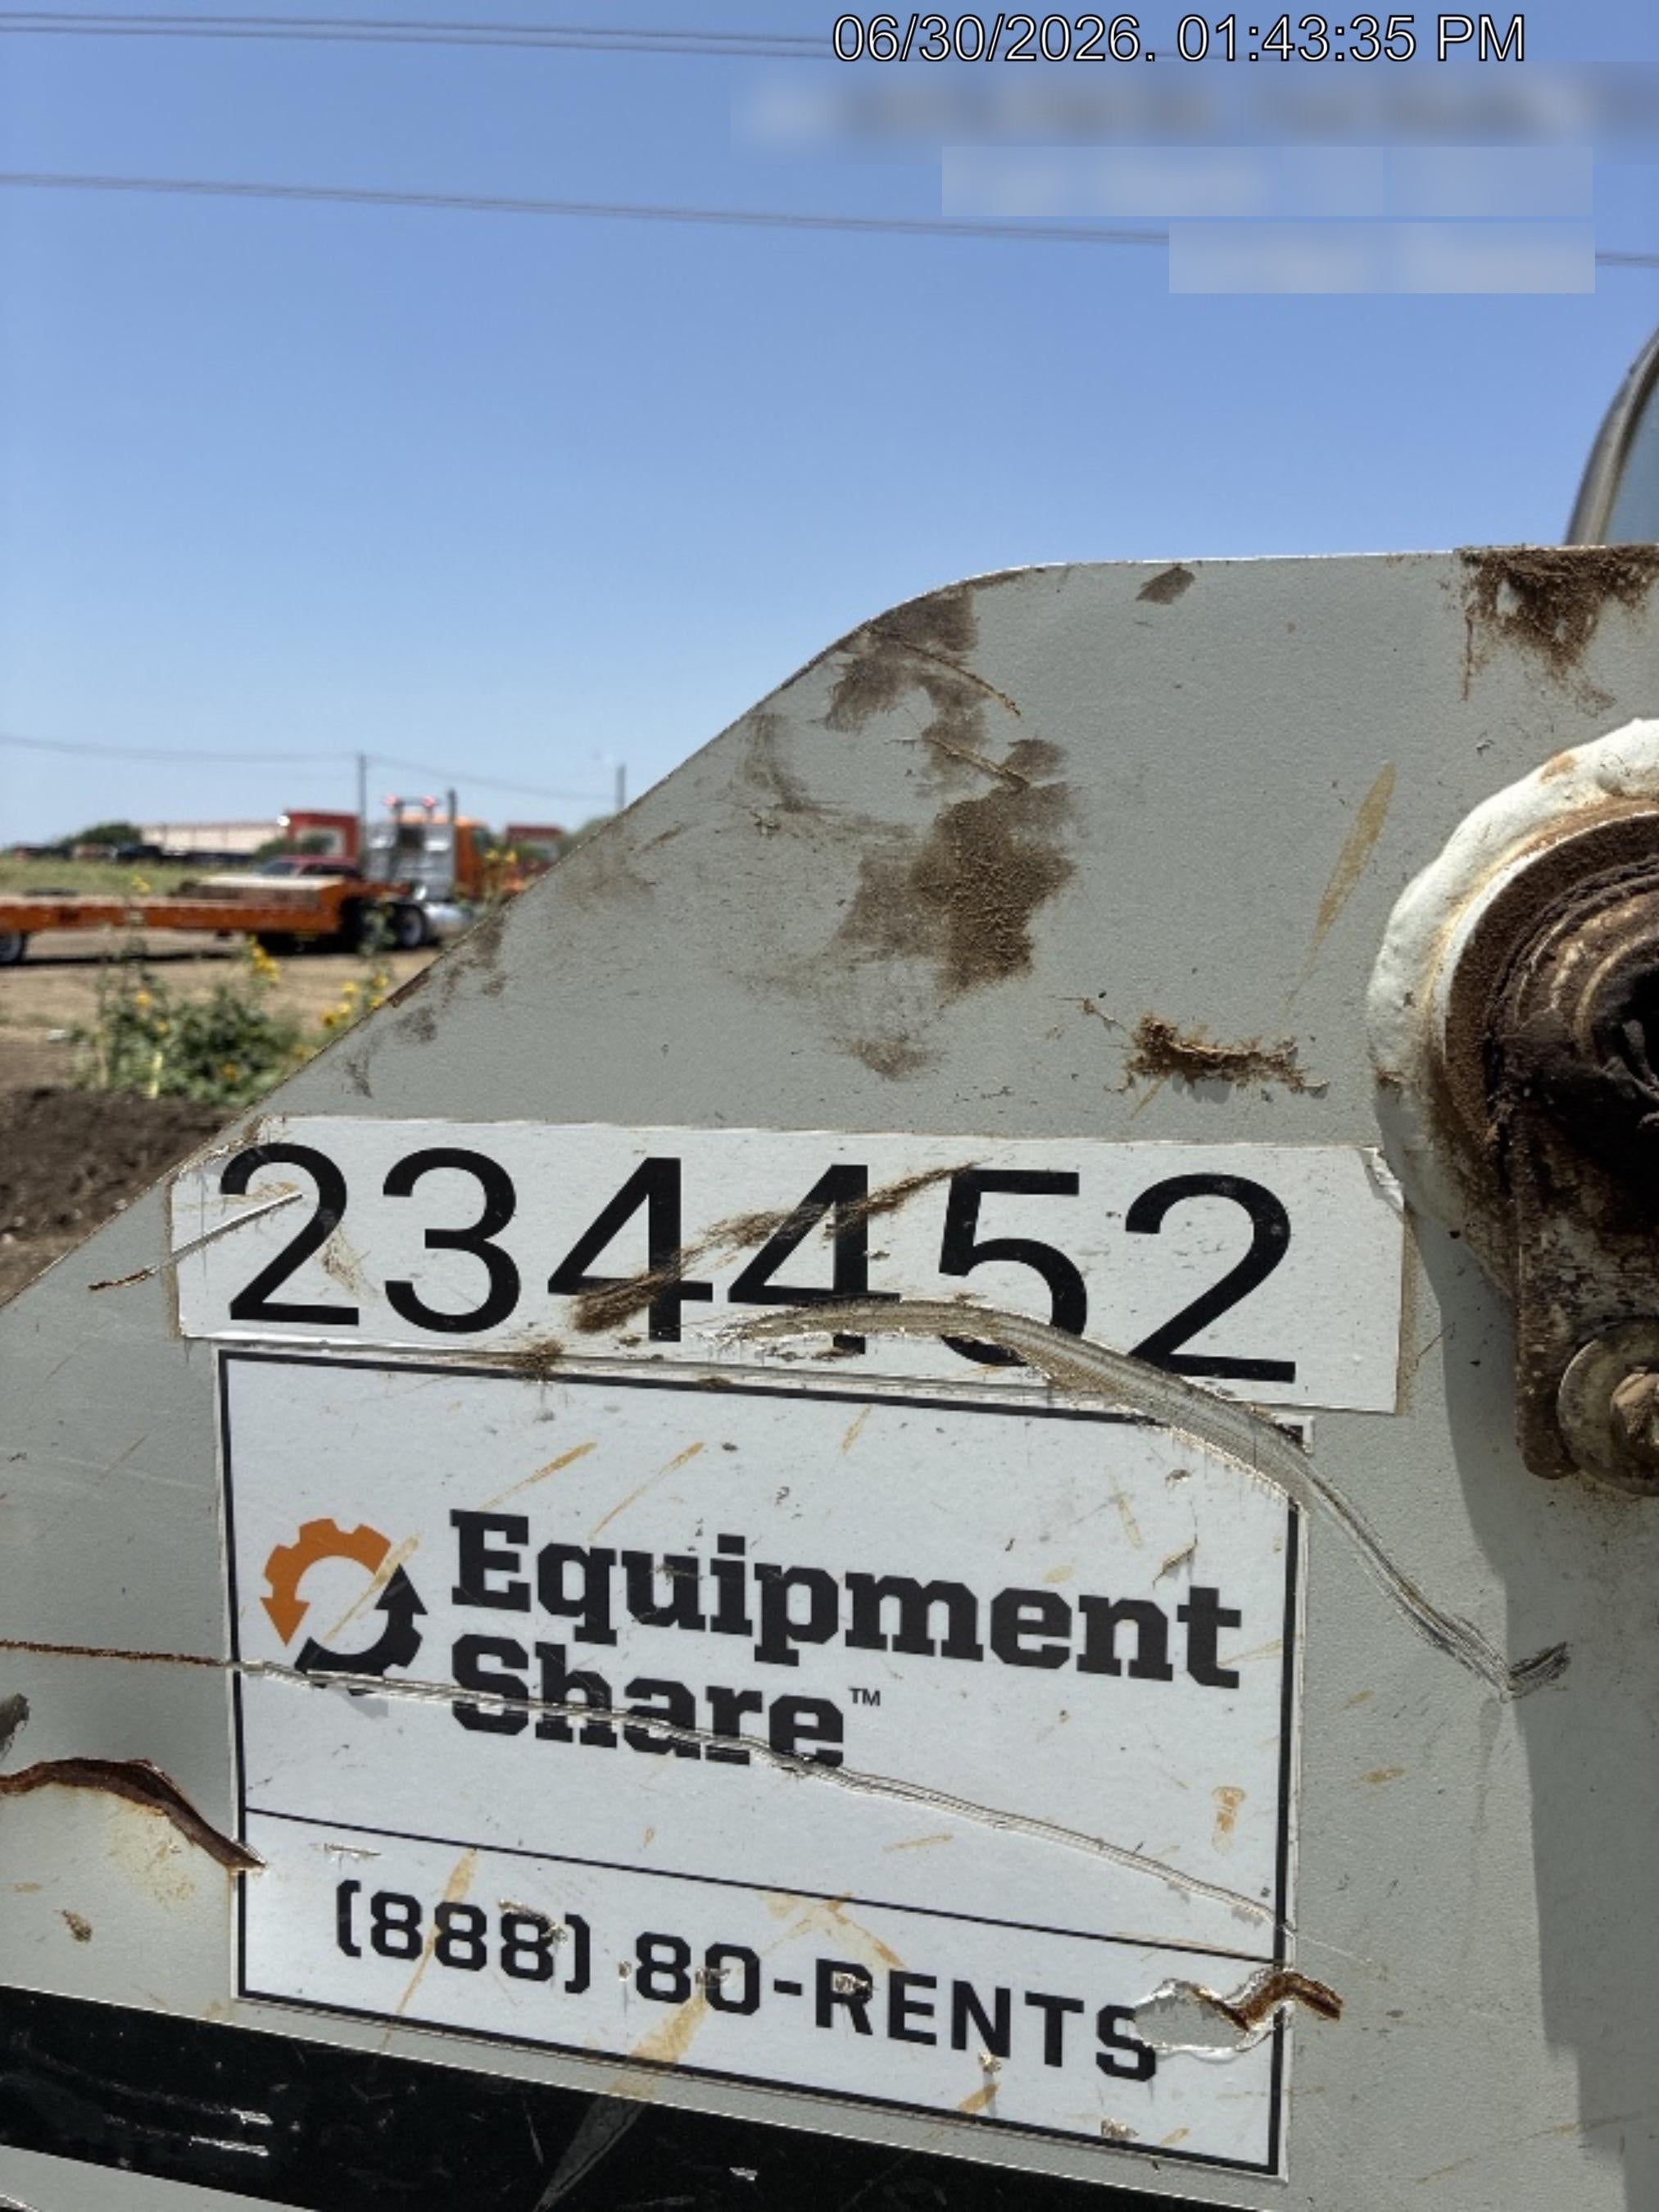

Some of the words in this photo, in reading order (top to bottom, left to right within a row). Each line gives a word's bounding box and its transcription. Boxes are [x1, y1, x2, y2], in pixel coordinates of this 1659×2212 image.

[220, 1142, 1297, 1385] 234452
[449, 1508, 1242, 1689] Equipment
[451, 1633, 845, 1769] Share
[336, 1879, 592, 1994] (888)
[634, 1933, 1157, 2082] 80-RENTS
